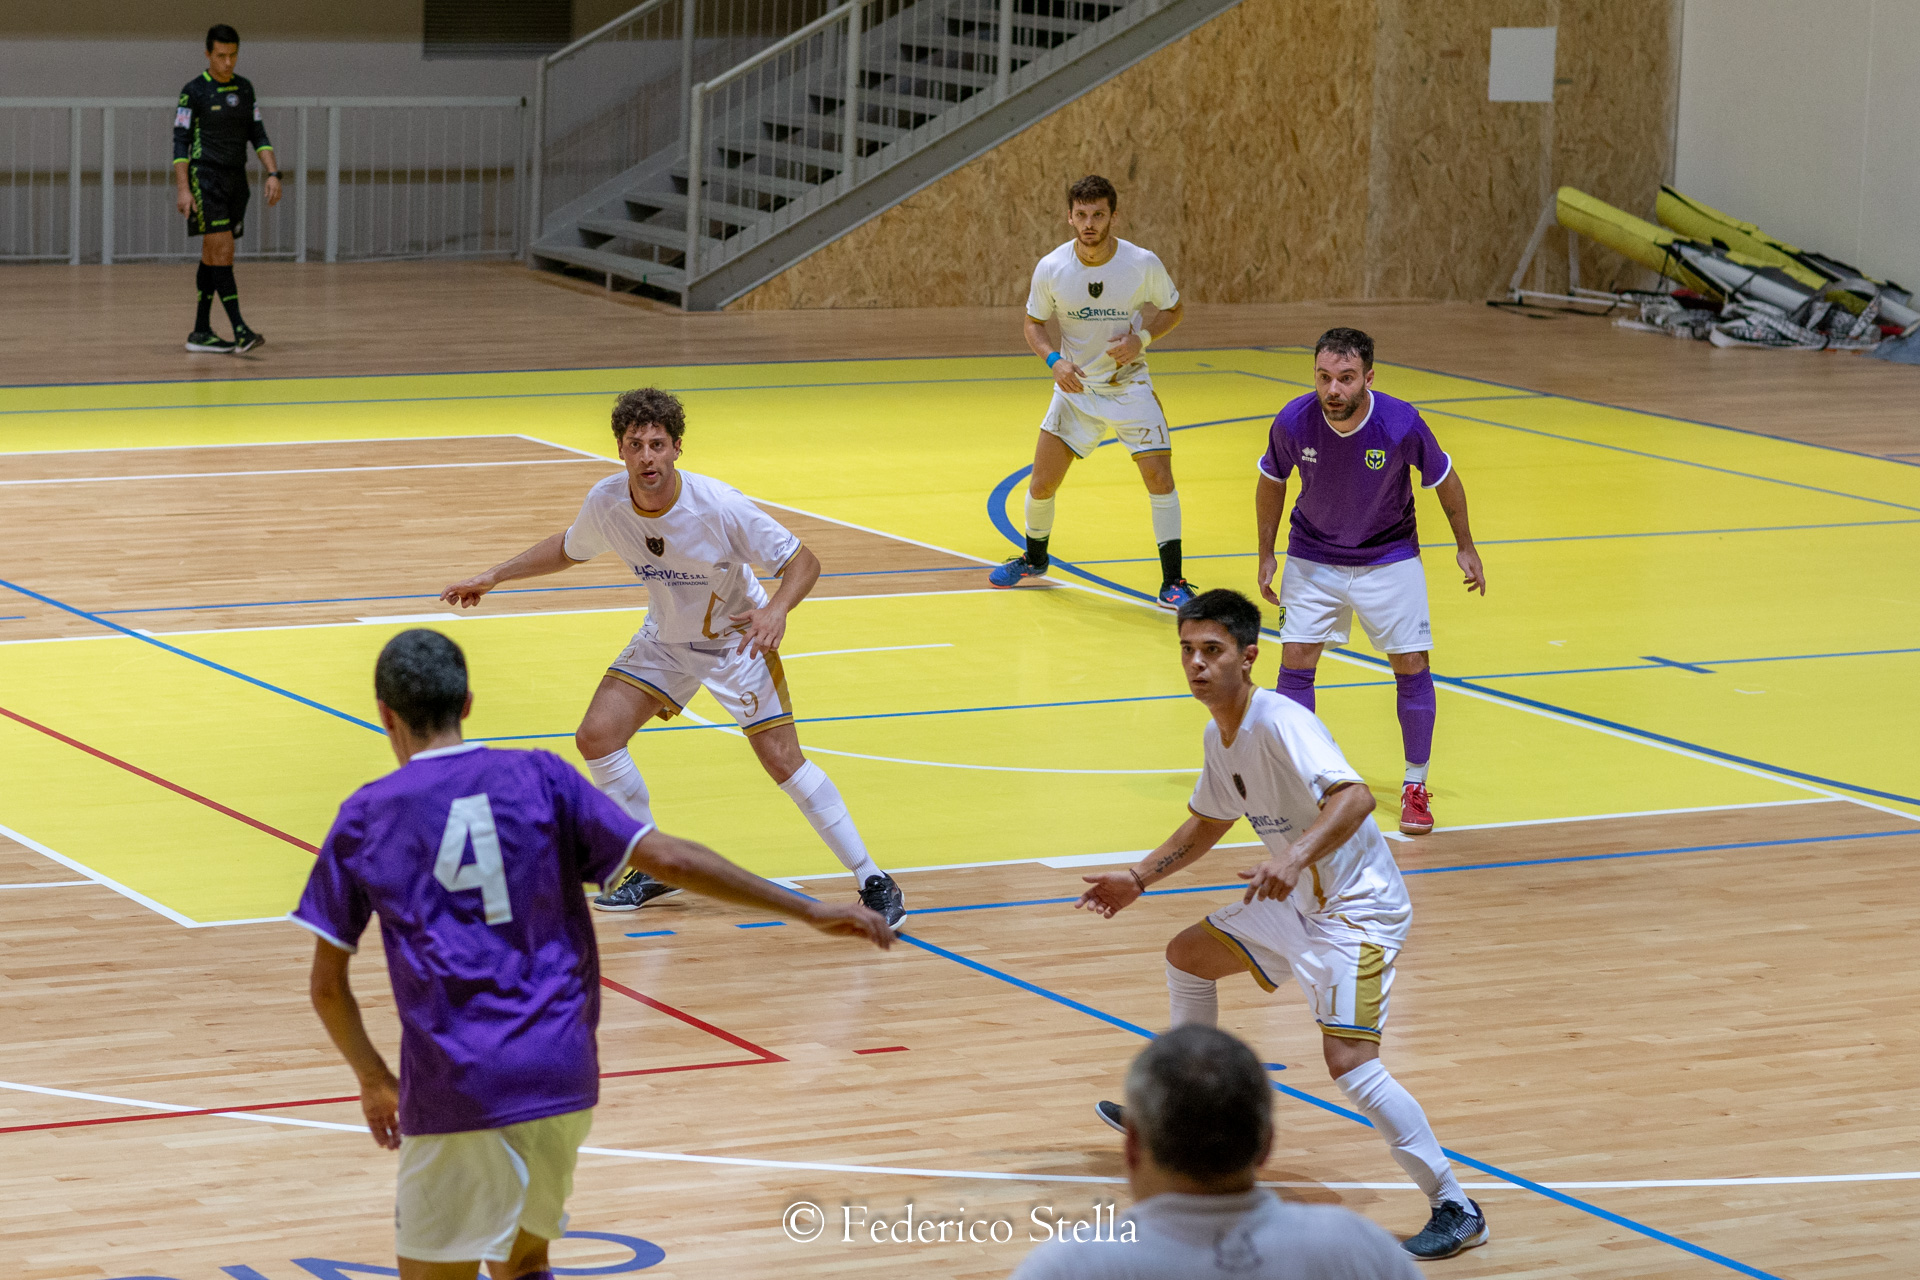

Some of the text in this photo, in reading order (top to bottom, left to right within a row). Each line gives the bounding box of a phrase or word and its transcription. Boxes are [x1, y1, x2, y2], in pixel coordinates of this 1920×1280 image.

[1138, 424, 1167, 445] 21
[739, 691, 759, 718] 9
[433, 792, 513, 925] 4
